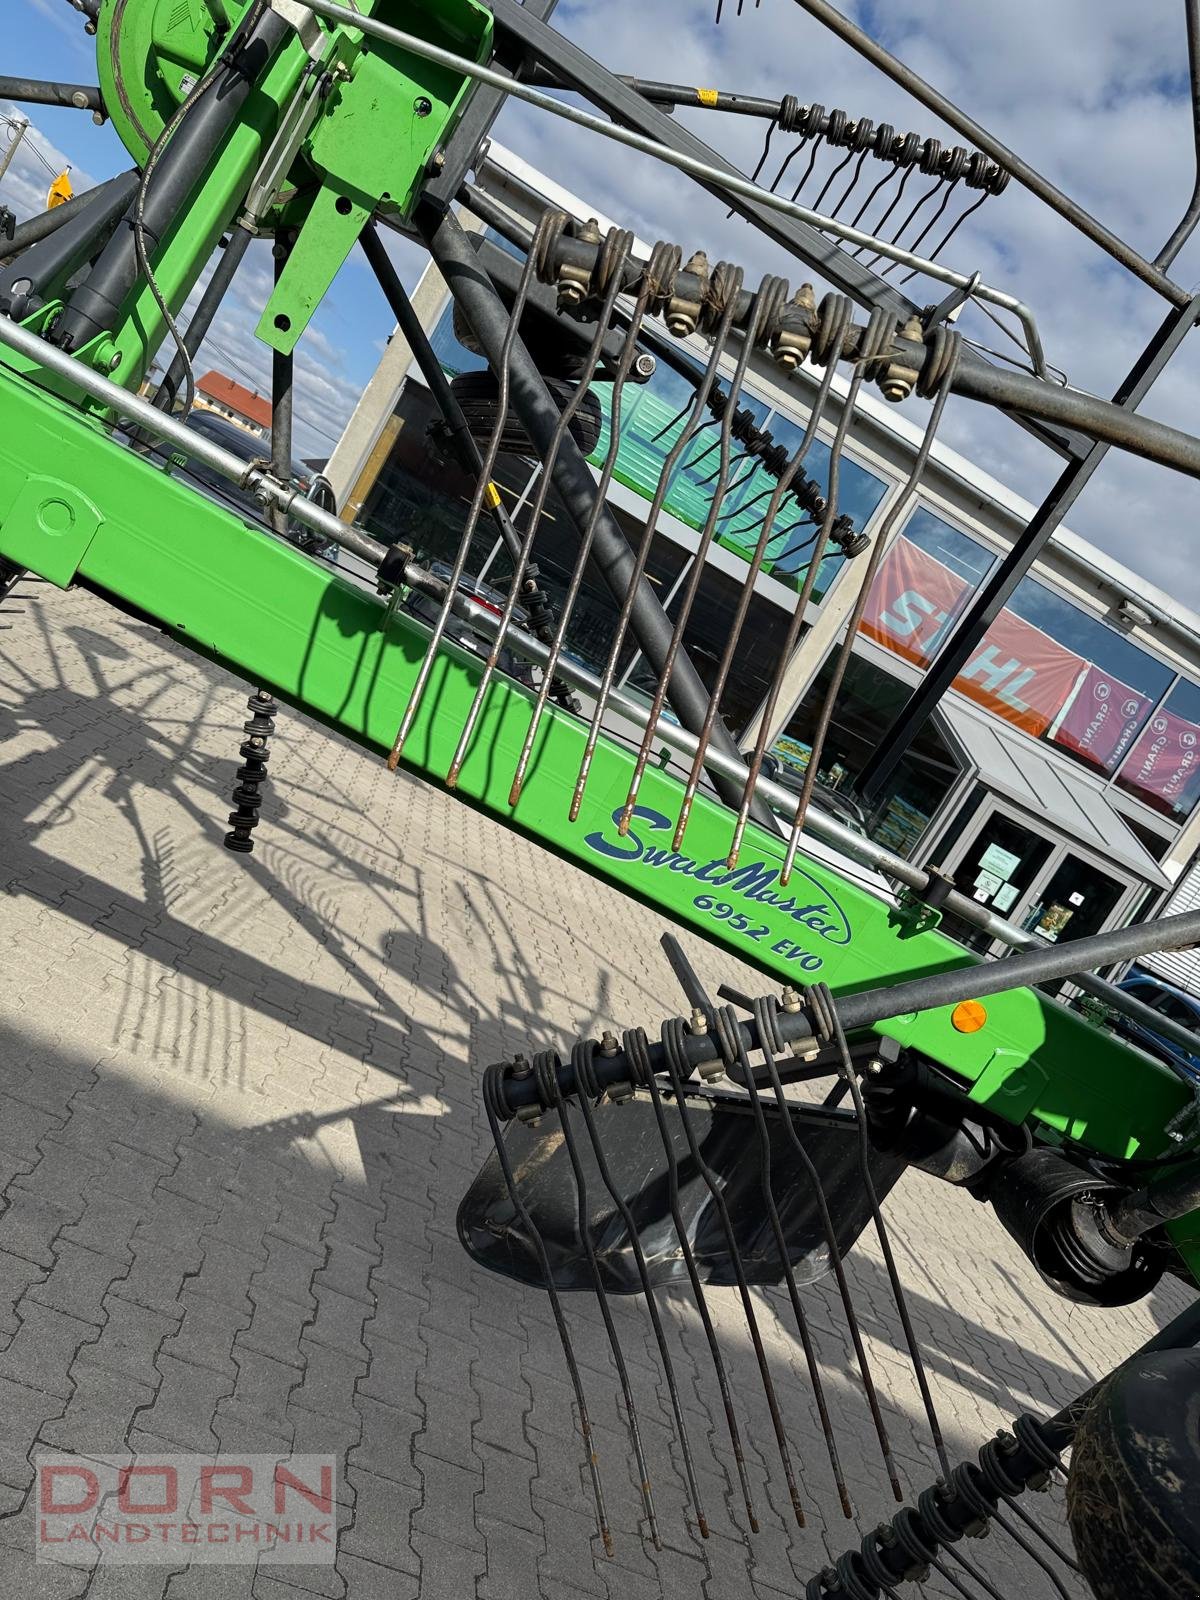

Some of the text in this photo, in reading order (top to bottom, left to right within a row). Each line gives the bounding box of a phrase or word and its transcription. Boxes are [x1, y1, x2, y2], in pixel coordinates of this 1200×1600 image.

[880, 589, 1038, 713] STHL
[584, 805, 850, 945] SwatMaster
[693, 894, 824, 973] 6952 EVO
